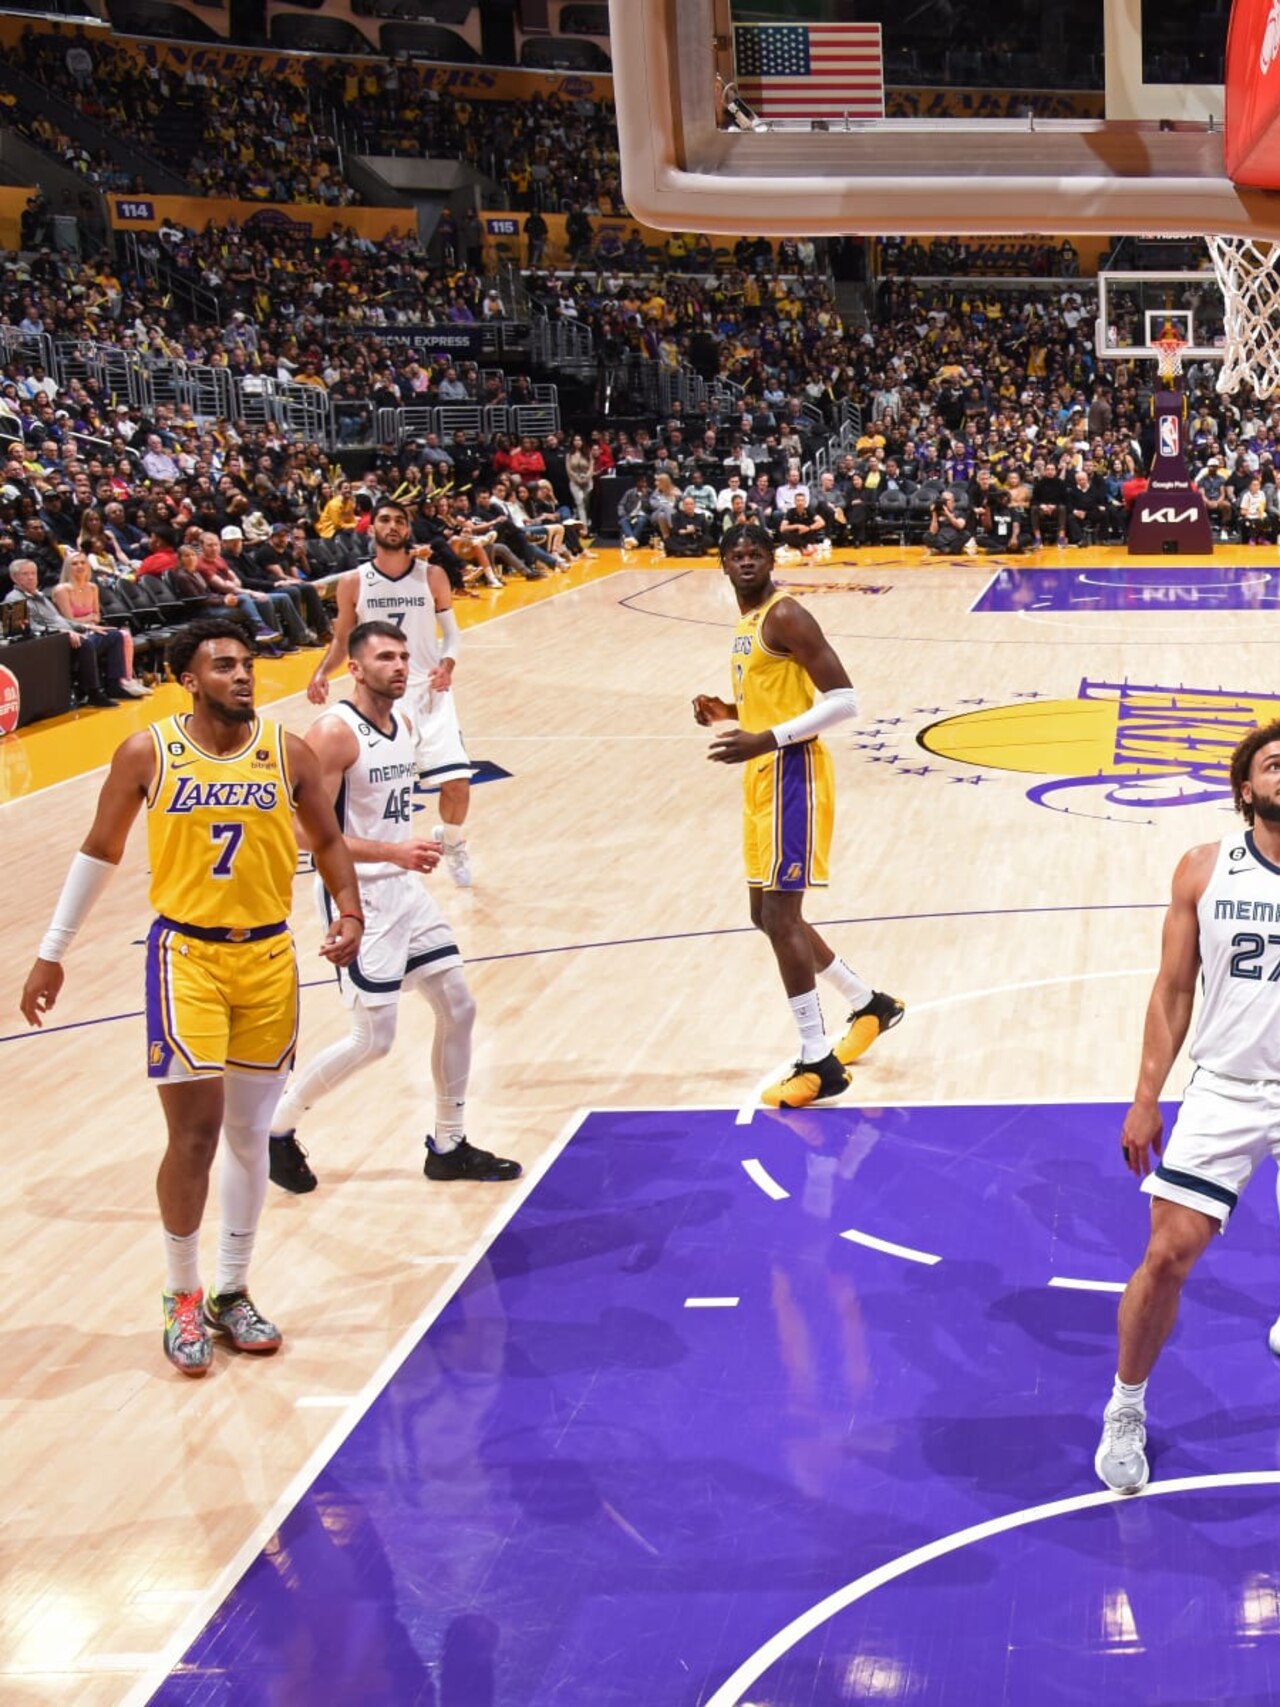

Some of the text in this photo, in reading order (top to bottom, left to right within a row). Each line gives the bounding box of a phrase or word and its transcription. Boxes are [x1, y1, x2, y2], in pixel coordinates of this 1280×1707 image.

[122, 203, 149, 218] 114
[491, 221, 515, 233] 115
[414, 336, 471, 347] EXPRESS
[366, 597, 426, 609] MEMPHIS
[171, 743, 183, 755] 6
[166, 777, 278, 813] LAKERS
[211, 822, 244, 879] 7
